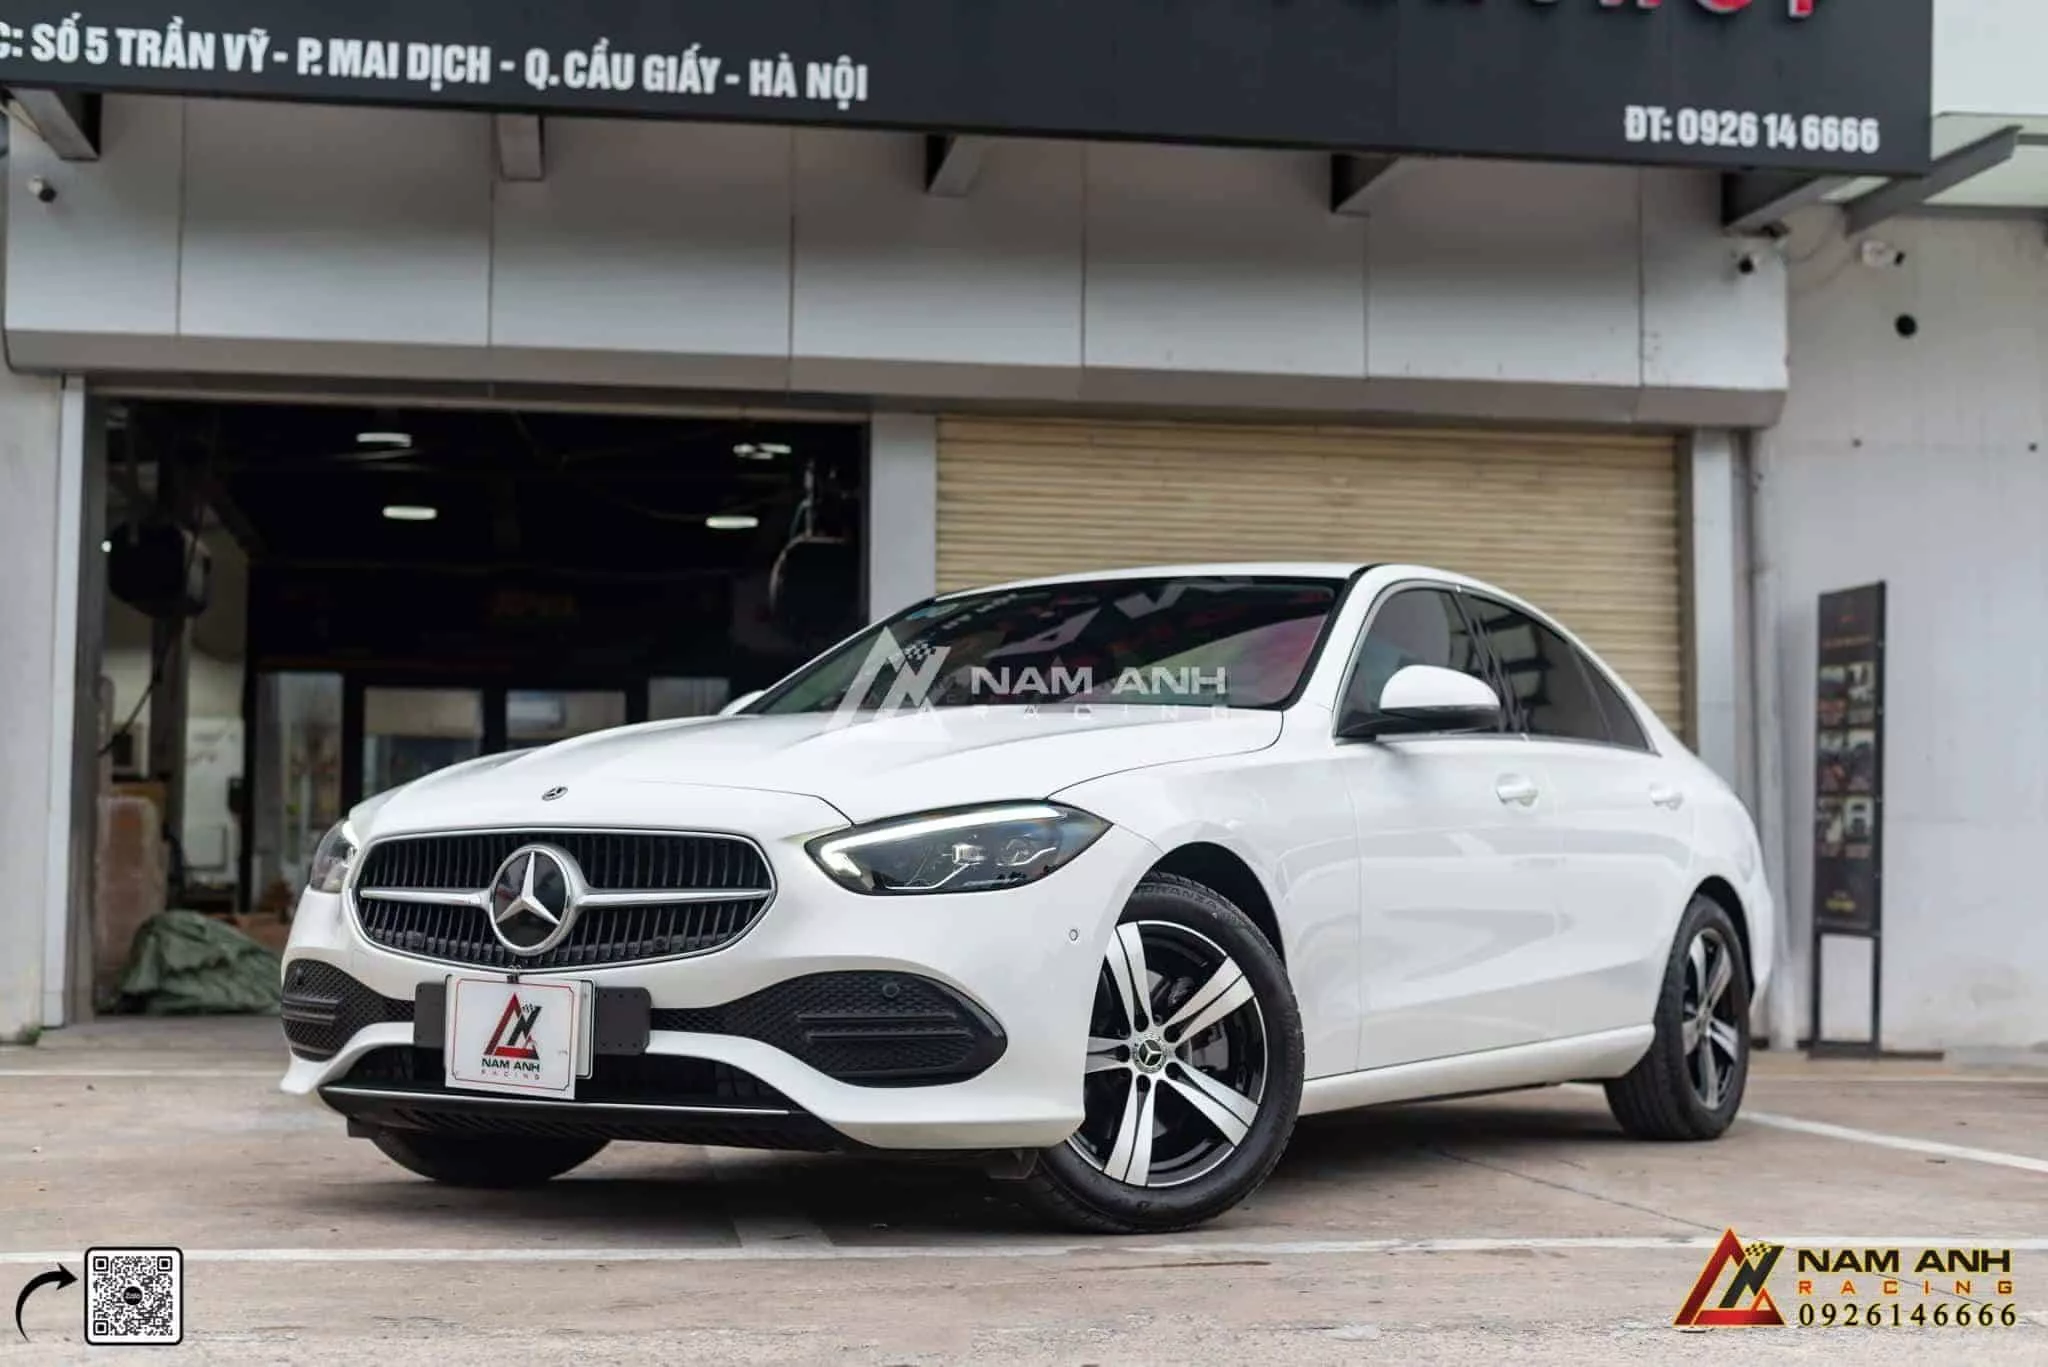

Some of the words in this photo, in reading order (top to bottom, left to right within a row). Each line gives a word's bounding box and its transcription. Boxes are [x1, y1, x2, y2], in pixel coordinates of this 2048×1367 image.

[31, 12, 81, 63] SỐ
[85, 27, 108, 64] 5
[115, 16, 215, 70] TRẦN
[223, 28, 270, 72] VỸ
[407, 43, 491, 91] DỊCH
[643, 43, 721, 94] GIẤY
[750, 53, 797, 97] HÀ
[807, 55, 867, 110] NỘI
[1624, 105, 1673, 142] ĐT:
[1677, 108, 1758, 147] 0926
[1763, 113, 1797, 149] 14
[1801, 115, 1879, 153] 6666
[481, 1058, 510, 1069] NAM
[513, 1060, 540, 1072] ANH
